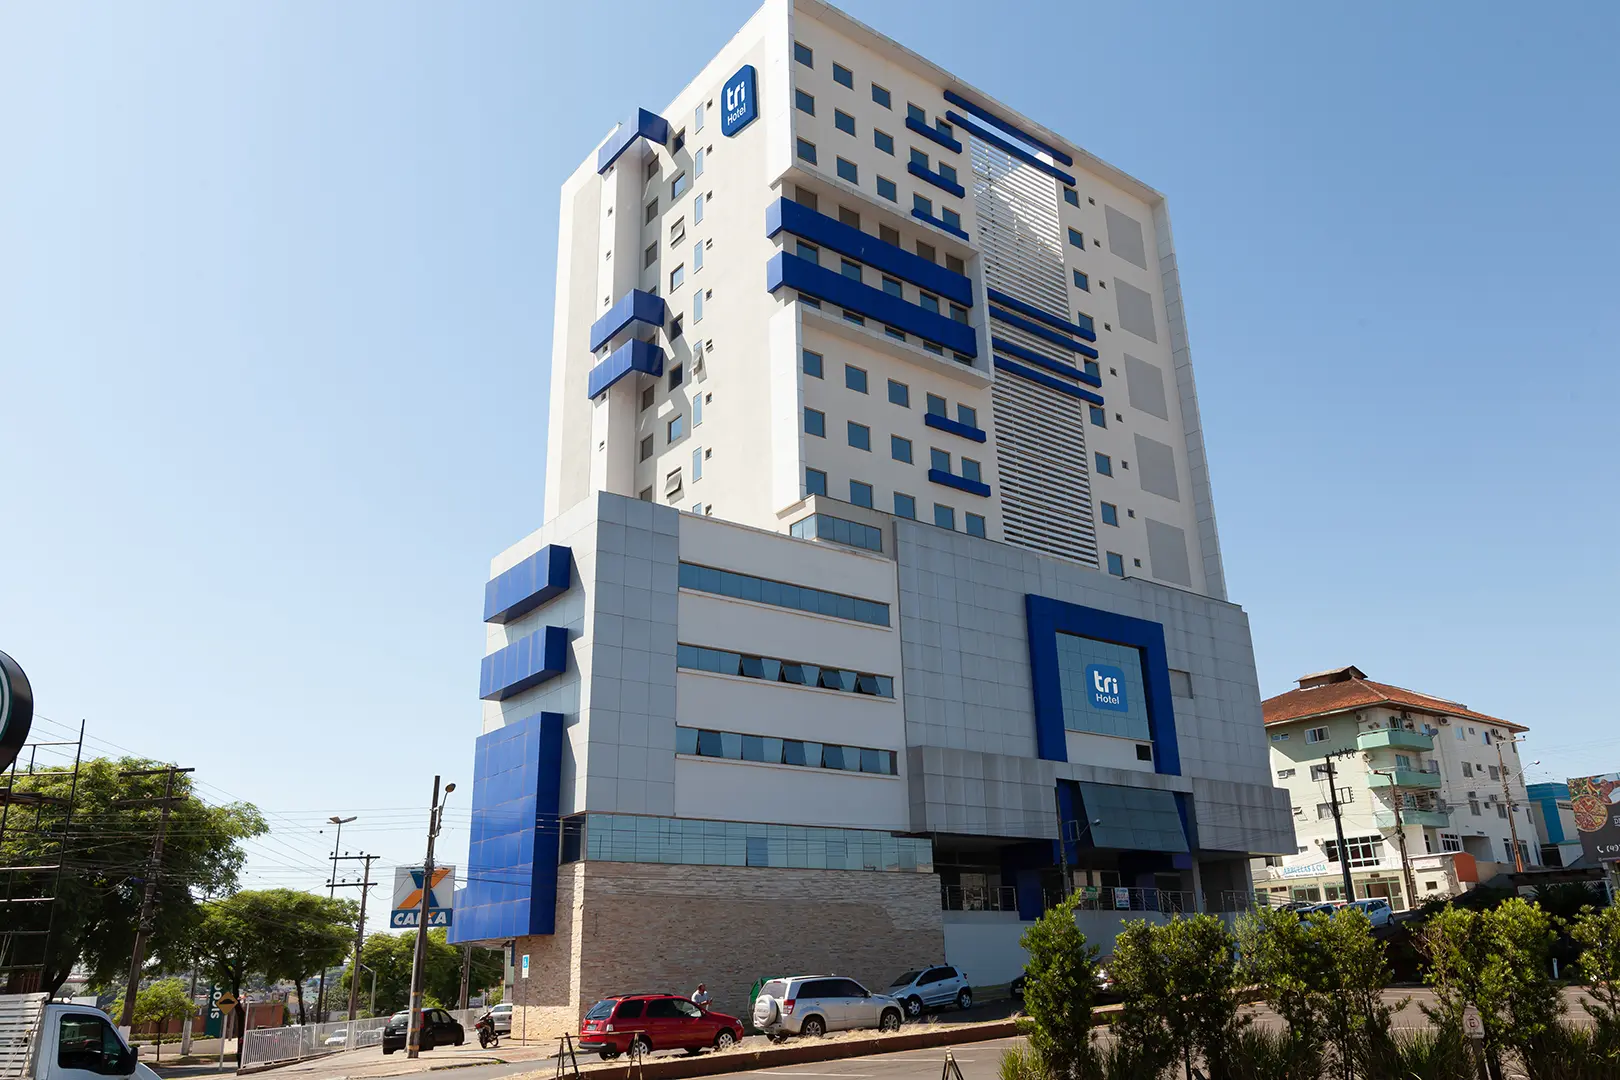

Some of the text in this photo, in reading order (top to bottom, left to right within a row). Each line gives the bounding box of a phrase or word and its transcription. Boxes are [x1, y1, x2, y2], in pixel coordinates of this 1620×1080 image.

[726, 81, 746, 111] tri
[727, 103, 746, 126] Hotel
[1093, 670, 1118, 694] tri
[1095, 693, 1120, 705] Hotel
